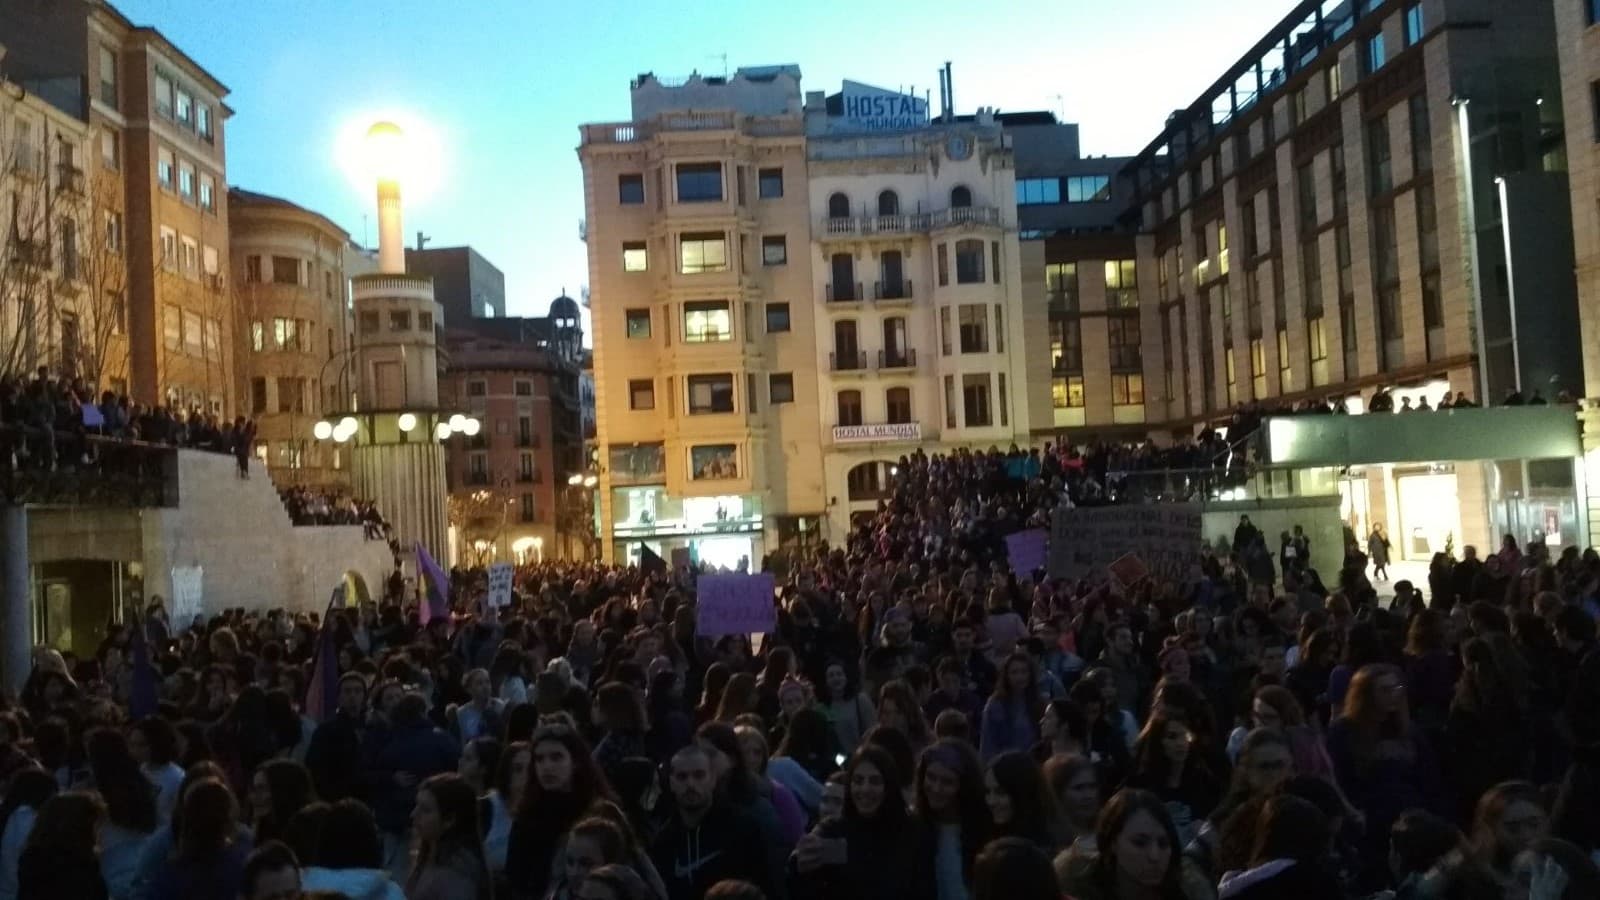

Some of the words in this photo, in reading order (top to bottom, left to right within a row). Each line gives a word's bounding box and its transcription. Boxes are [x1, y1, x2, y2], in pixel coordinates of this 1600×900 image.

[847, 95, 924, 117] HOSTAL
[866, 117, 919, 129] MUNDIAL
[835, 427, 870, 438] HOSTAL
[874, 424, 918, 436] MUNDIAL
